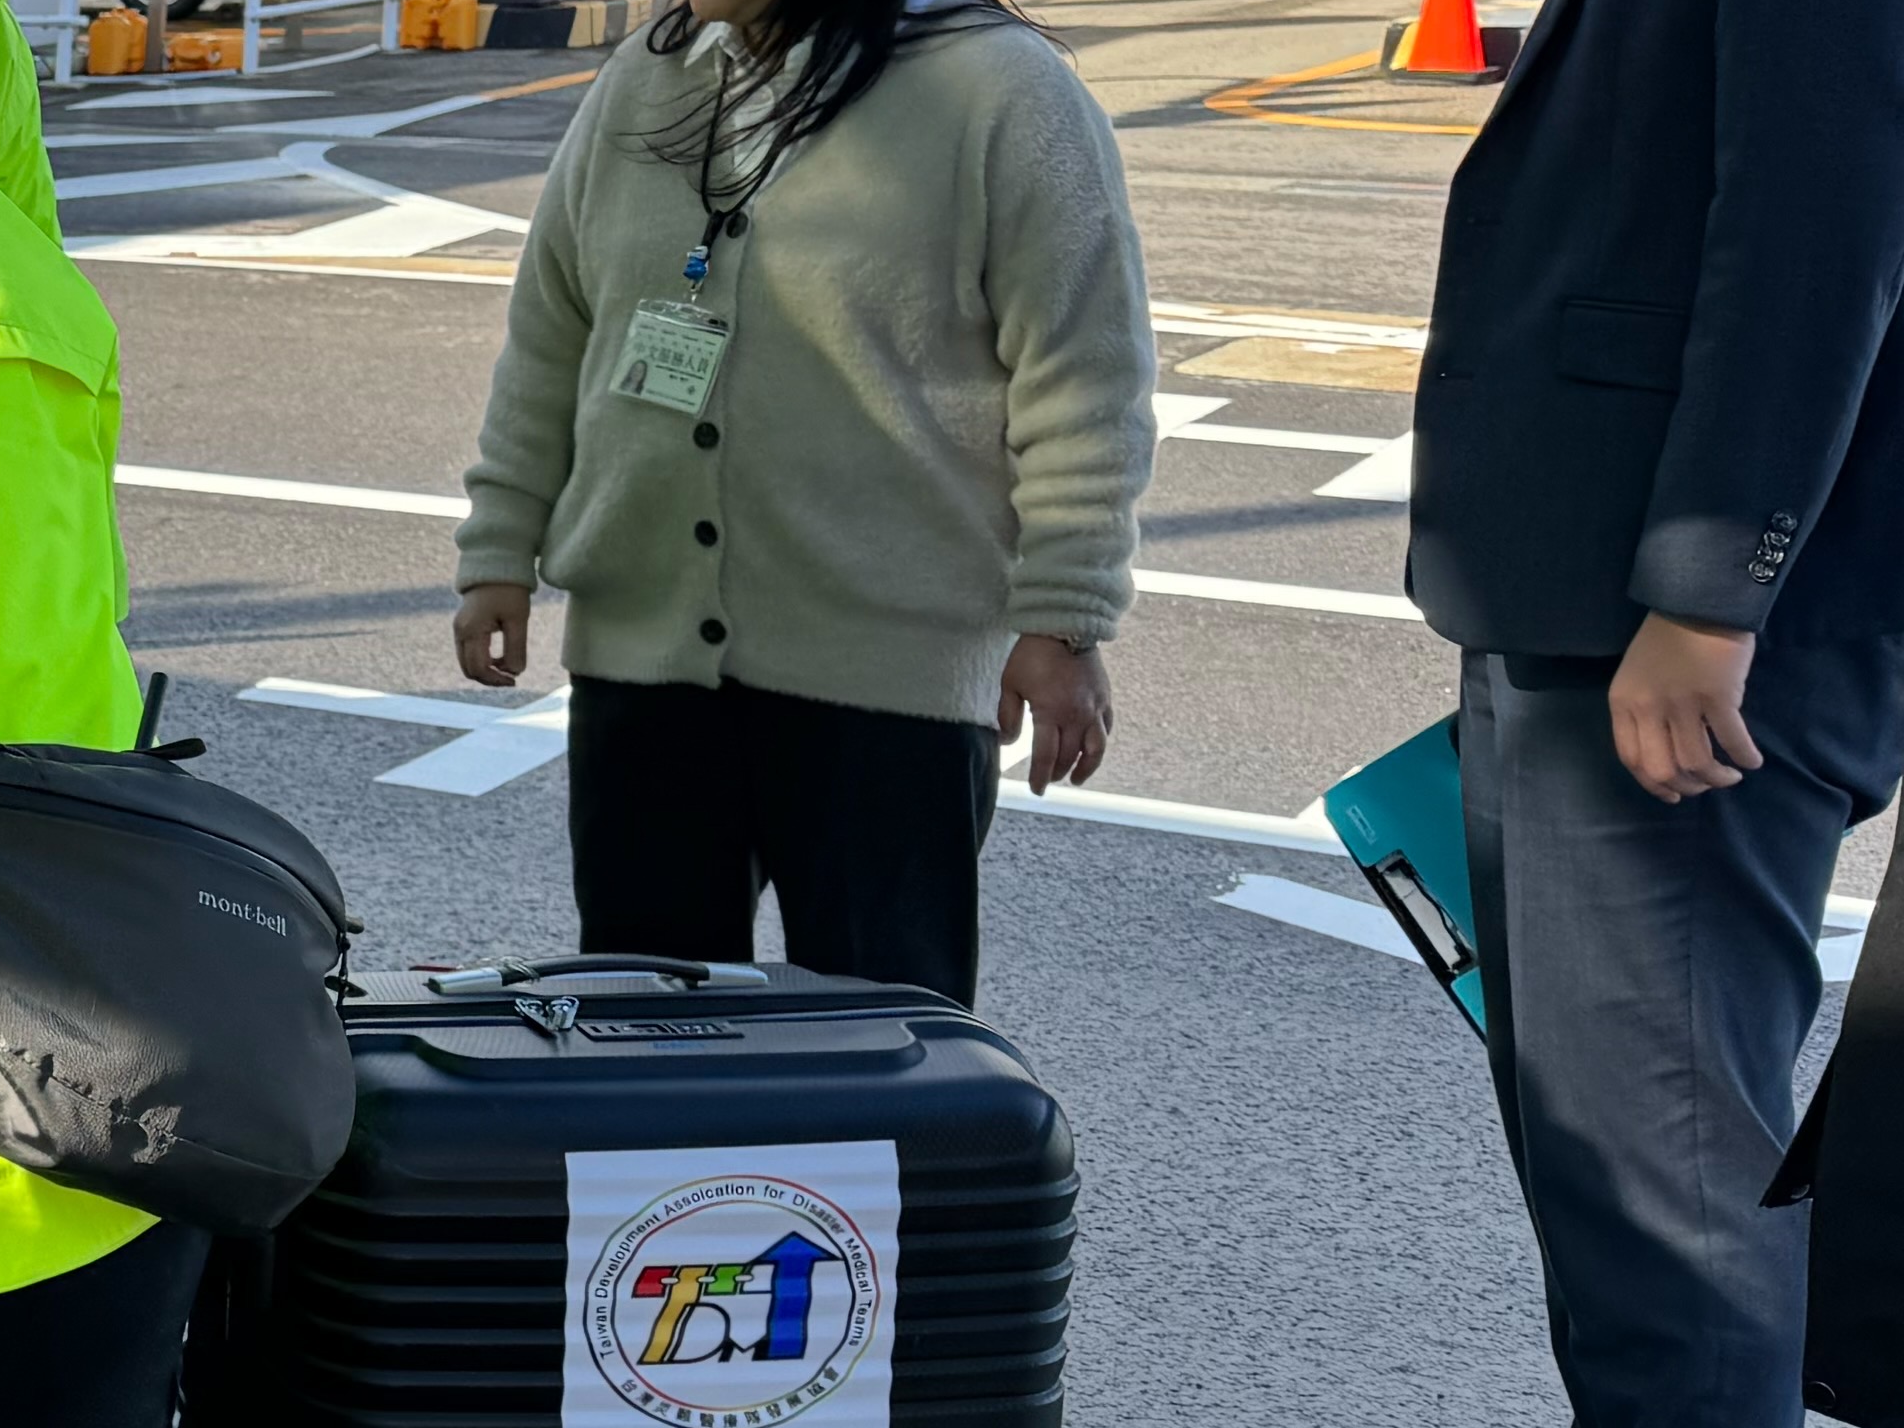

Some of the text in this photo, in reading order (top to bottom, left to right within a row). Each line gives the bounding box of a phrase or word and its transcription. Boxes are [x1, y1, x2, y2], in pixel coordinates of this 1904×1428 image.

[764, 1183, 786, 1201] for
[792, 1192, 846, 1236] Disaster
[595, 1213, 662, 1299] Development
[844, 1237, 873, 1293] Medical
[594, 1305, 616, 1360] Taiwan
